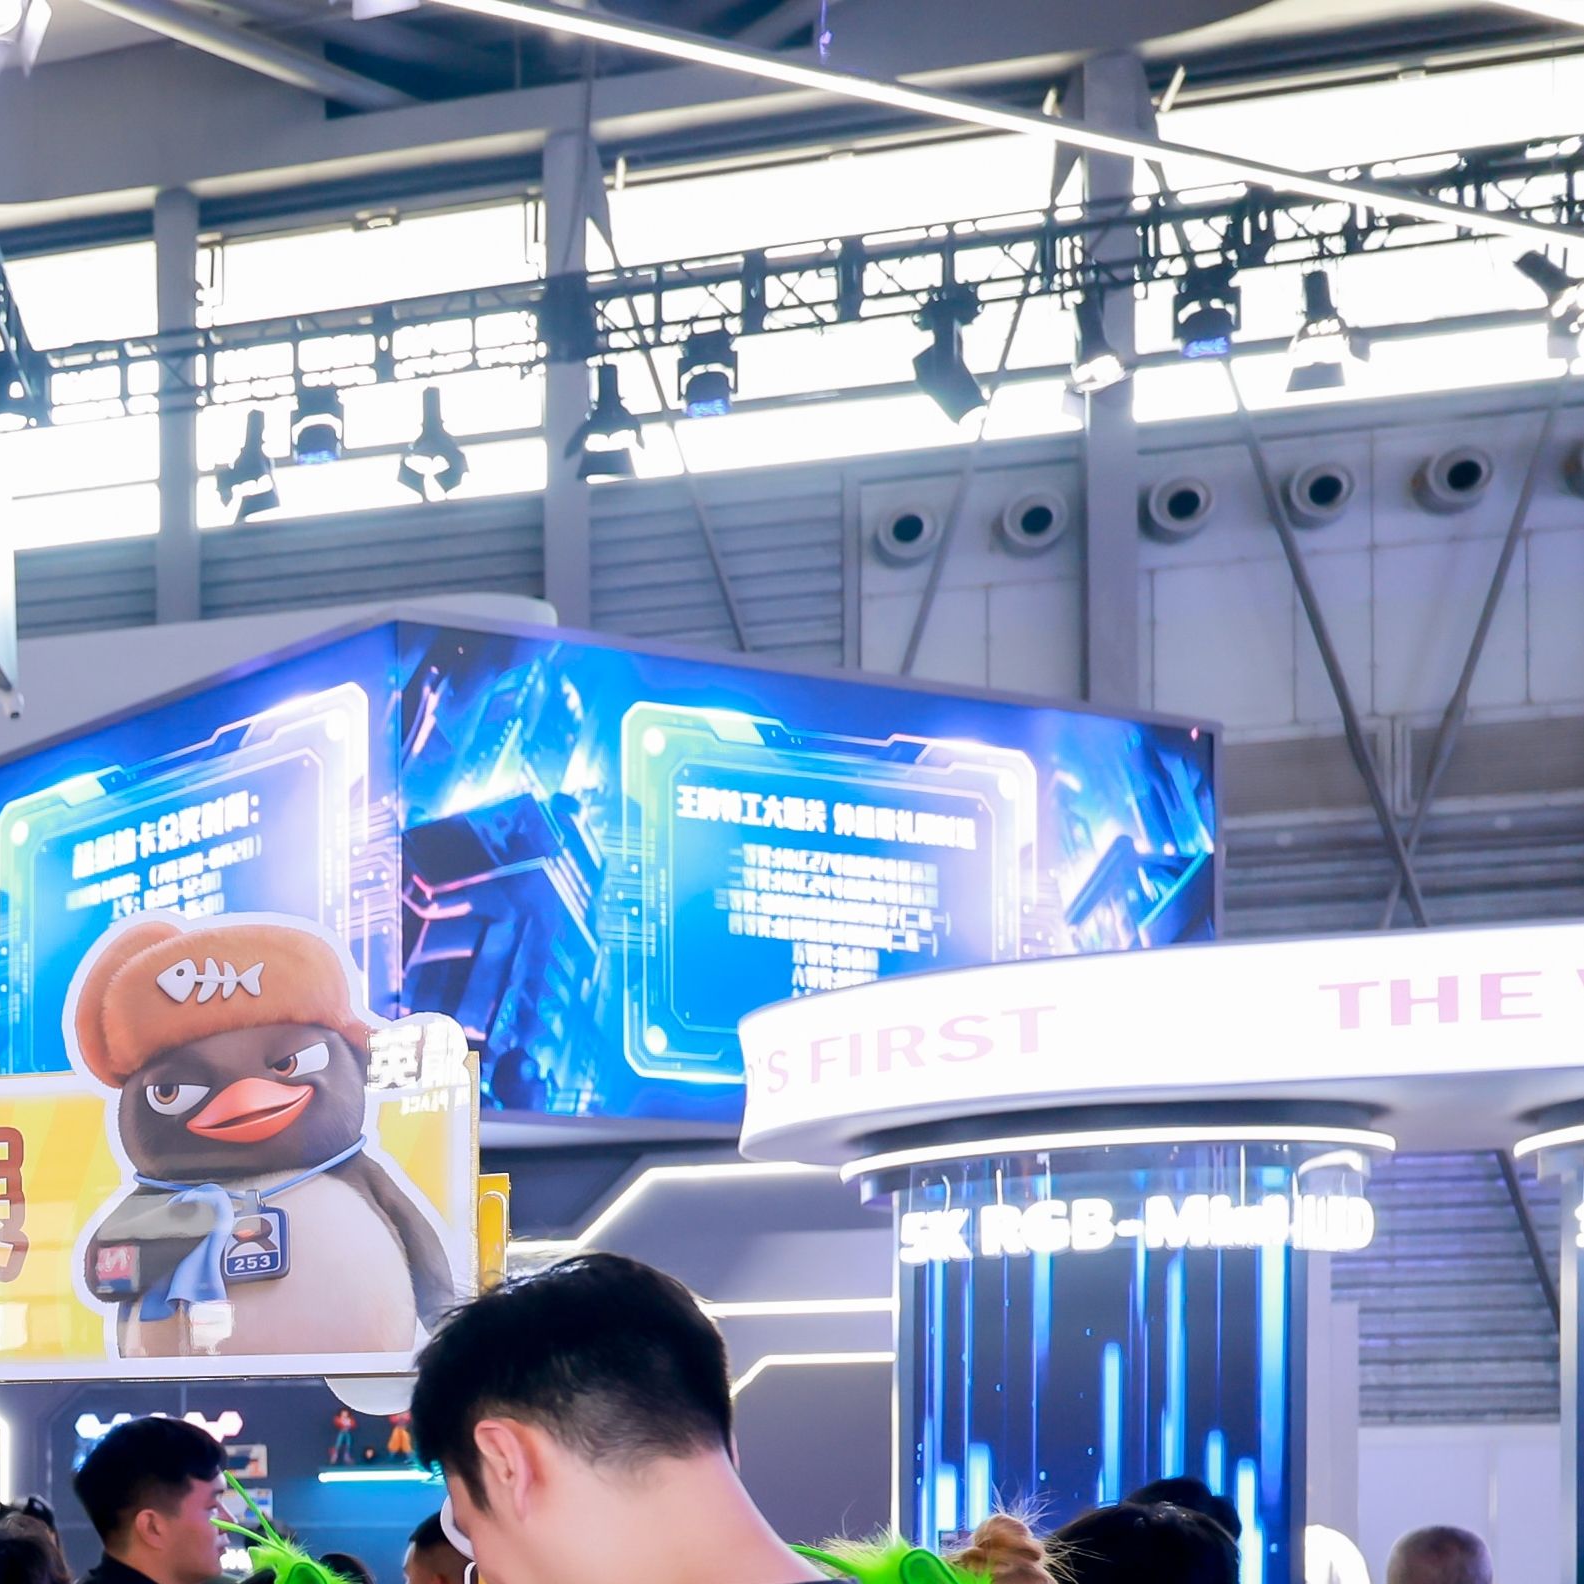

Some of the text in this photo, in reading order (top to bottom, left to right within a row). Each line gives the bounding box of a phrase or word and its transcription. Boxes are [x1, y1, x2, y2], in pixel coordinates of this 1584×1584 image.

[1319, 971, 1542, 1029] THE
[810, 1004, 1057, 1084] FIRST
[234, 1253, 272, 1272] 253
